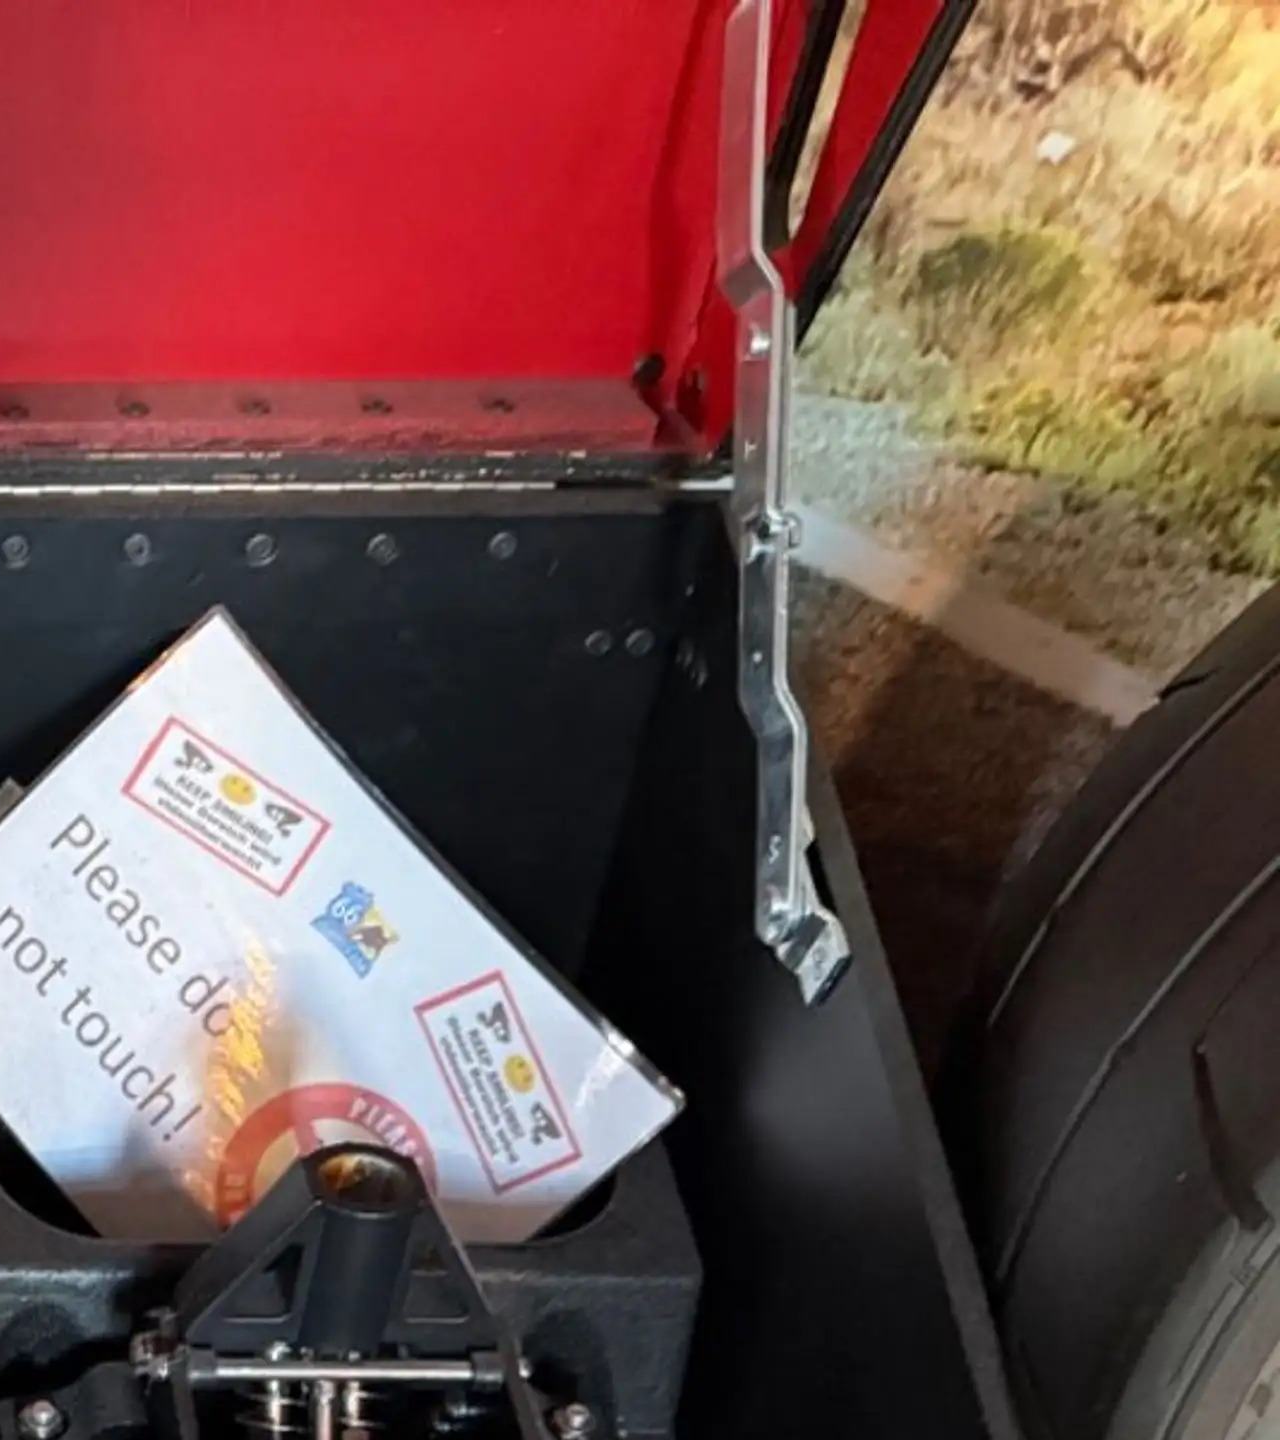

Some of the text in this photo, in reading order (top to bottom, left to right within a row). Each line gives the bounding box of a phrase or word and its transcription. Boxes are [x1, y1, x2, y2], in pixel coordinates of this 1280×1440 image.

[50, 812, 182, 976] Please
[59, 985, 203, 1142] touch!
[347, 1096, 425, 1167] PLEAS
